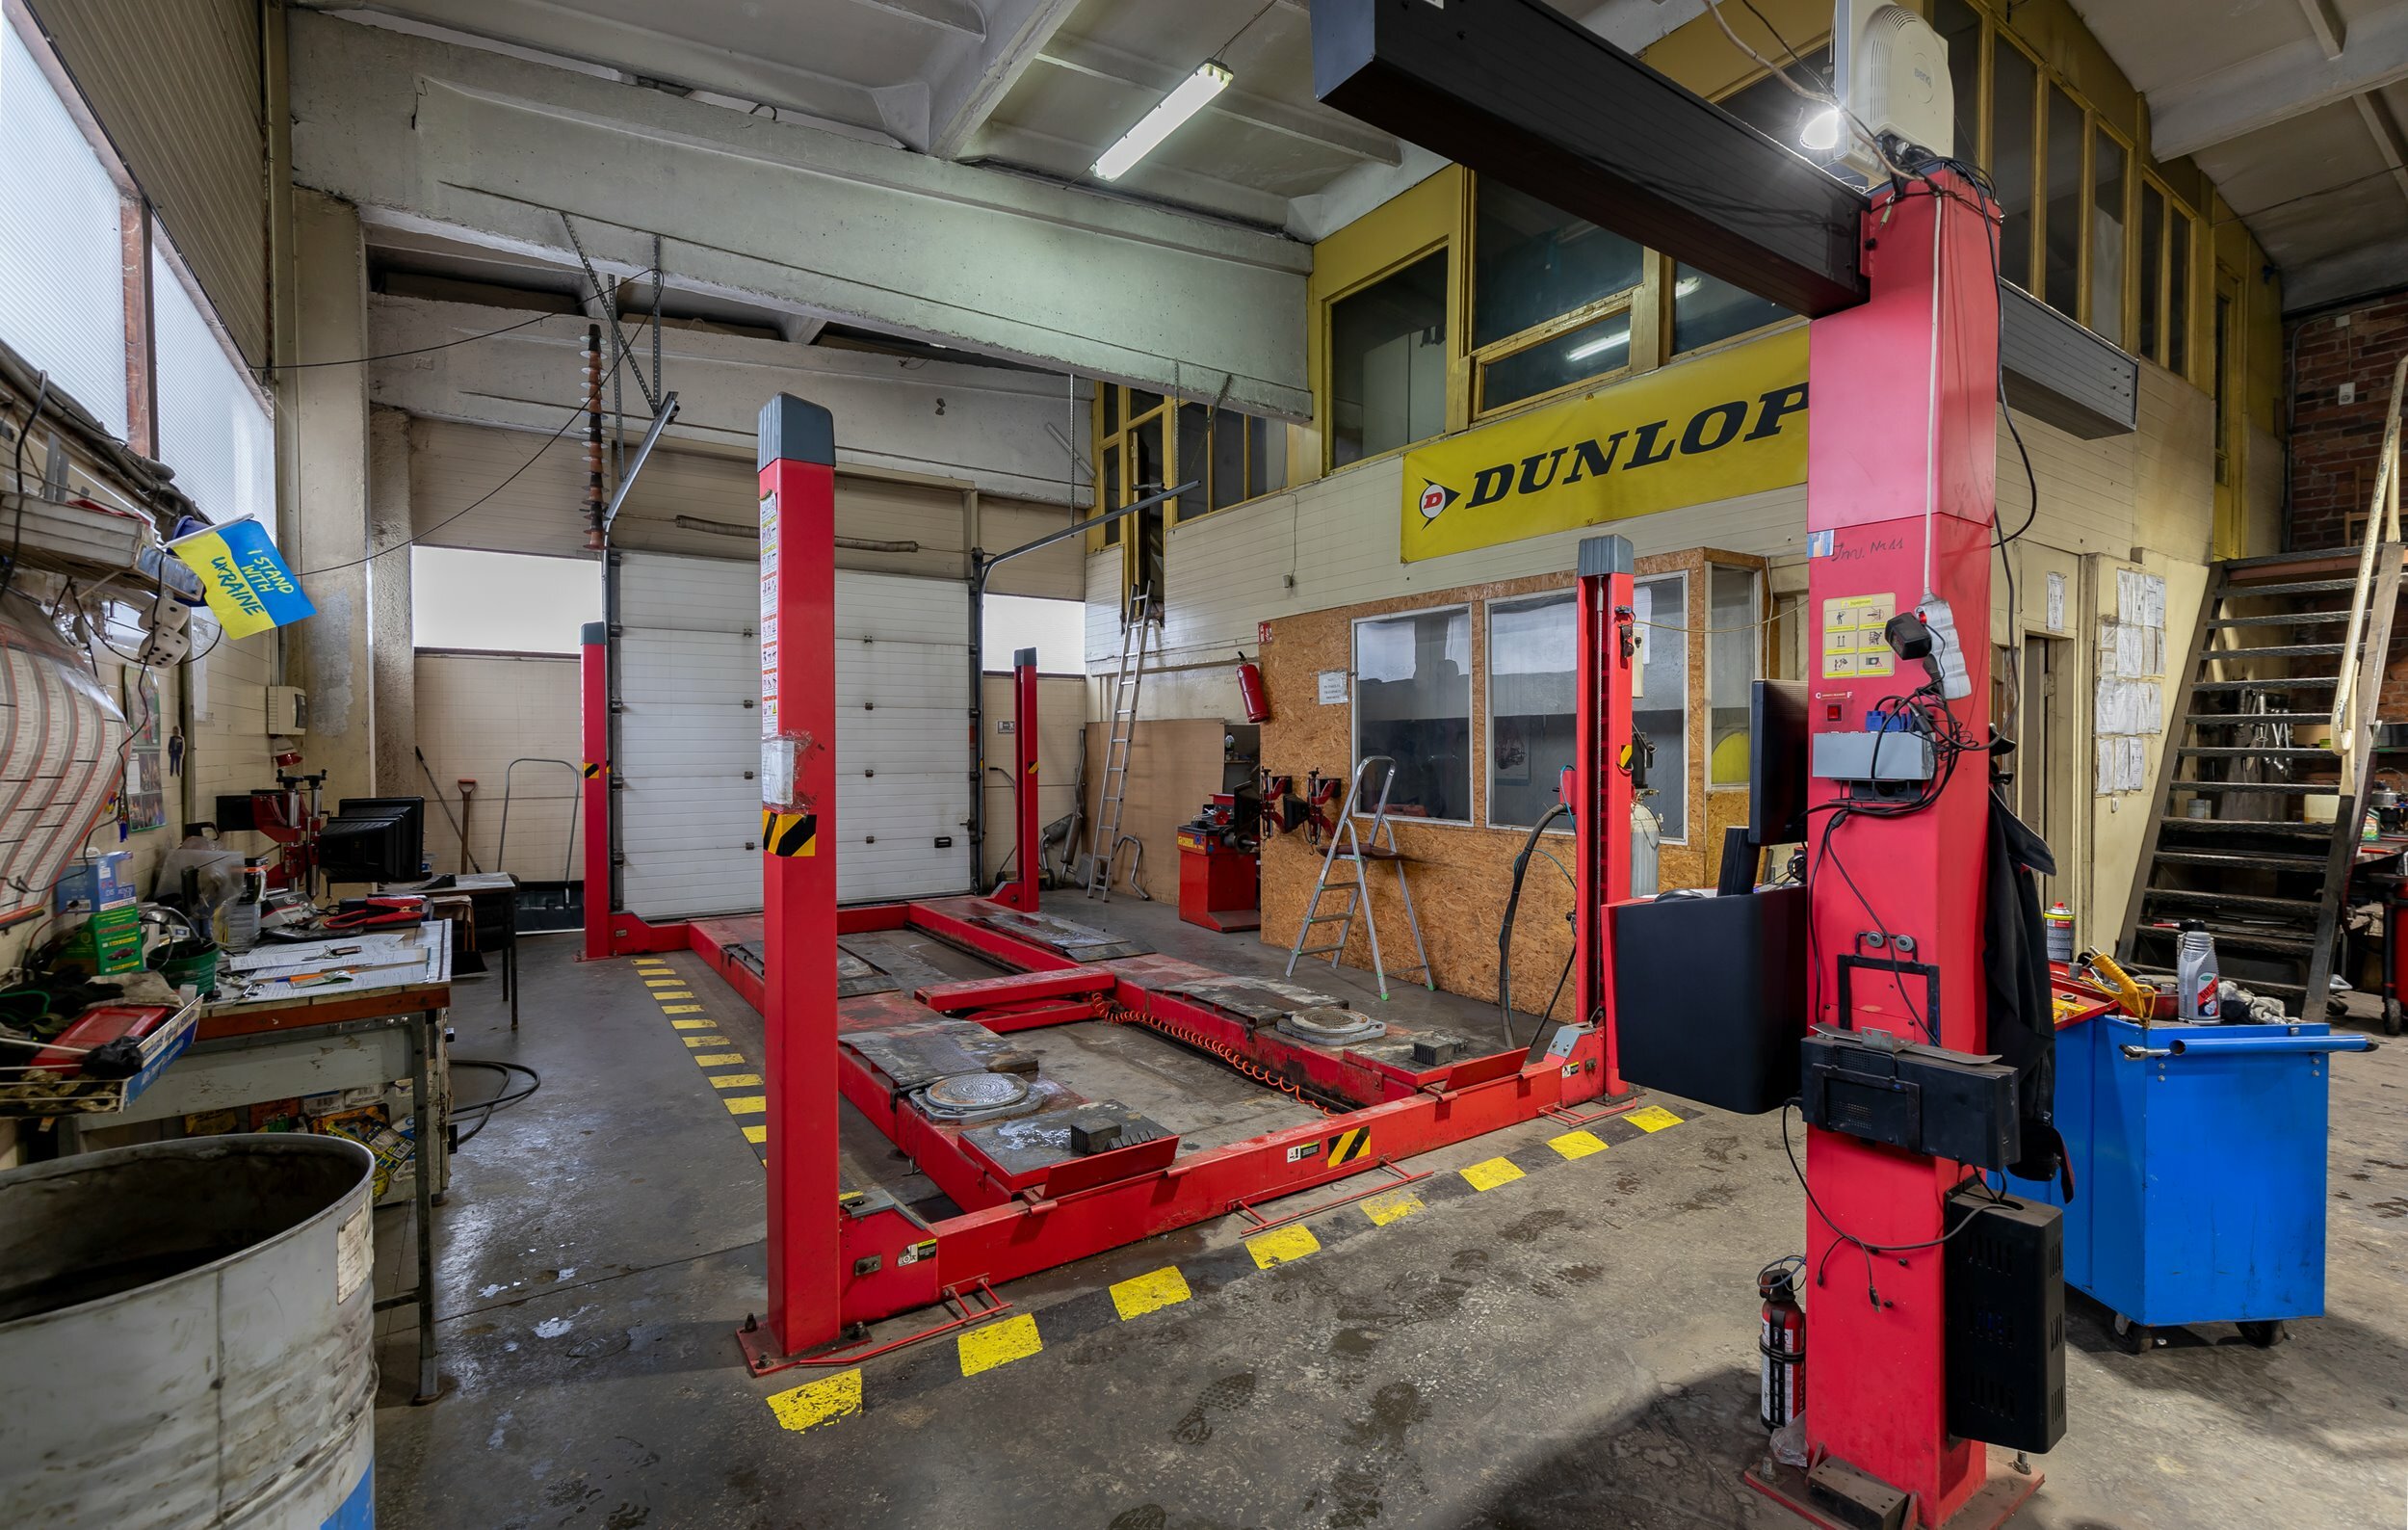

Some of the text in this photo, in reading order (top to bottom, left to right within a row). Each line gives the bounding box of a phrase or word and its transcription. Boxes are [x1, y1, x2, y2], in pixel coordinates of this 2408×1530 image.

[1465, 382, 1809, 510] DUNLOP
[211, 556, 266, 616] UKRAINE
[241, 565, 275, 593] WITH
[253, 556, 295, 594] STAND
